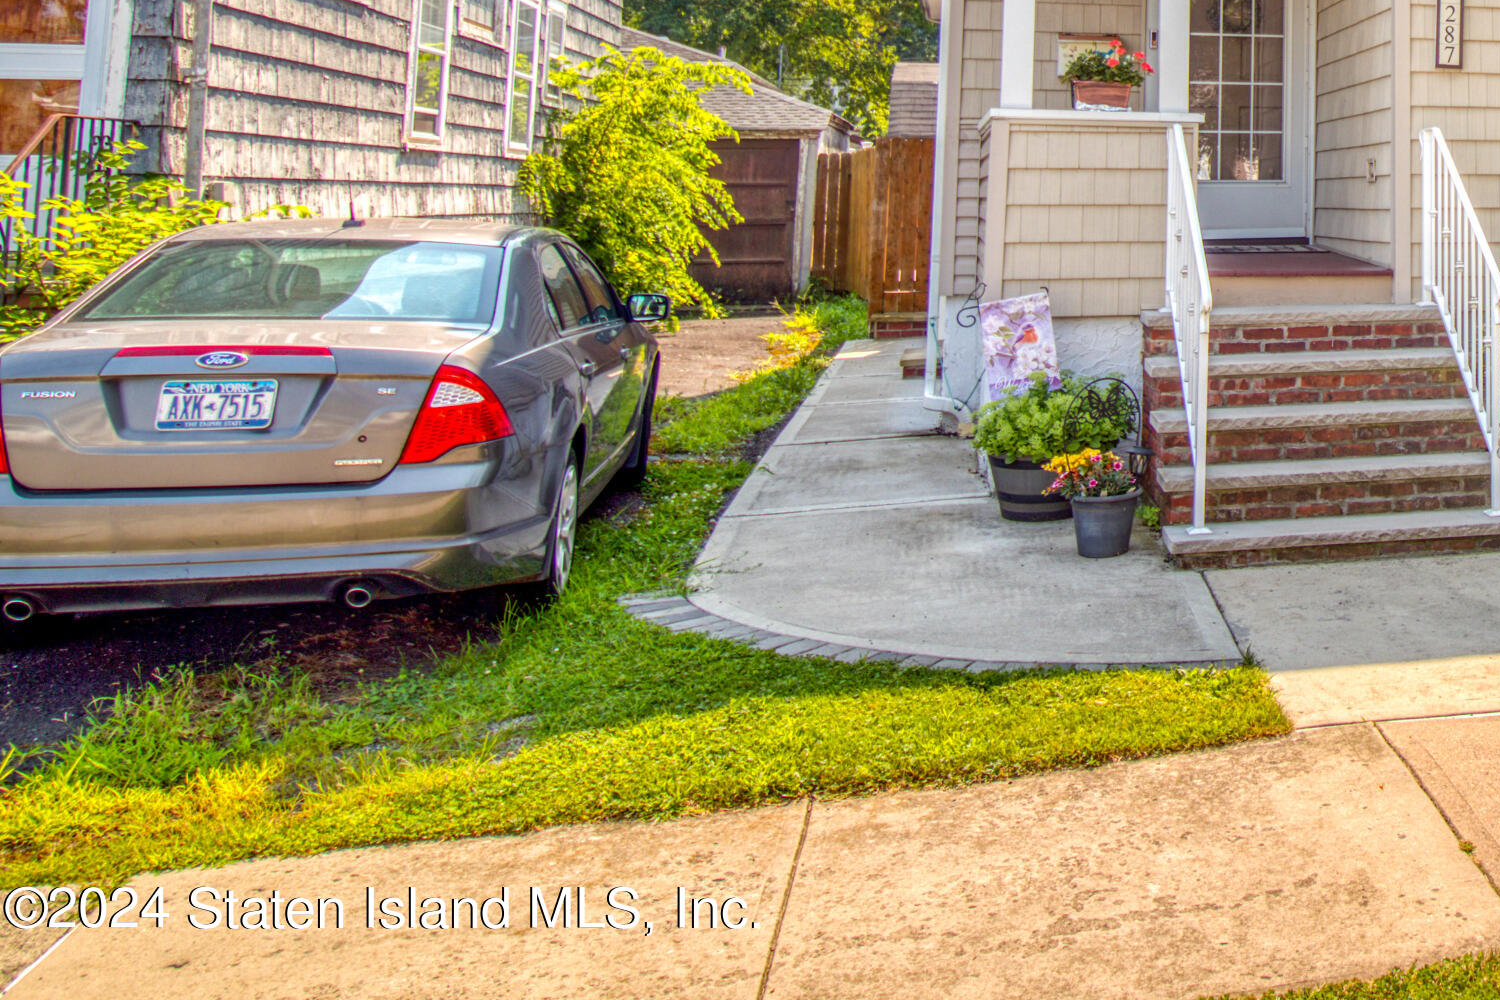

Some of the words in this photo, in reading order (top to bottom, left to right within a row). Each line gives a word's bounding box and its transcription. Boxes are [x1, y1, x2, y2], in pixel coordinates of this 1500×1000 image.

[1444, 5, 1456, 63] 287
[206, 353, 236, 365] Ford
[190, 383, 217, 393] NEW
[220, 382, 249, 393] YORK
[20, 391, 77, 399] FUSION
[168, 395, 204, 419] AXK
[218, 394, 264, 418] 7515
